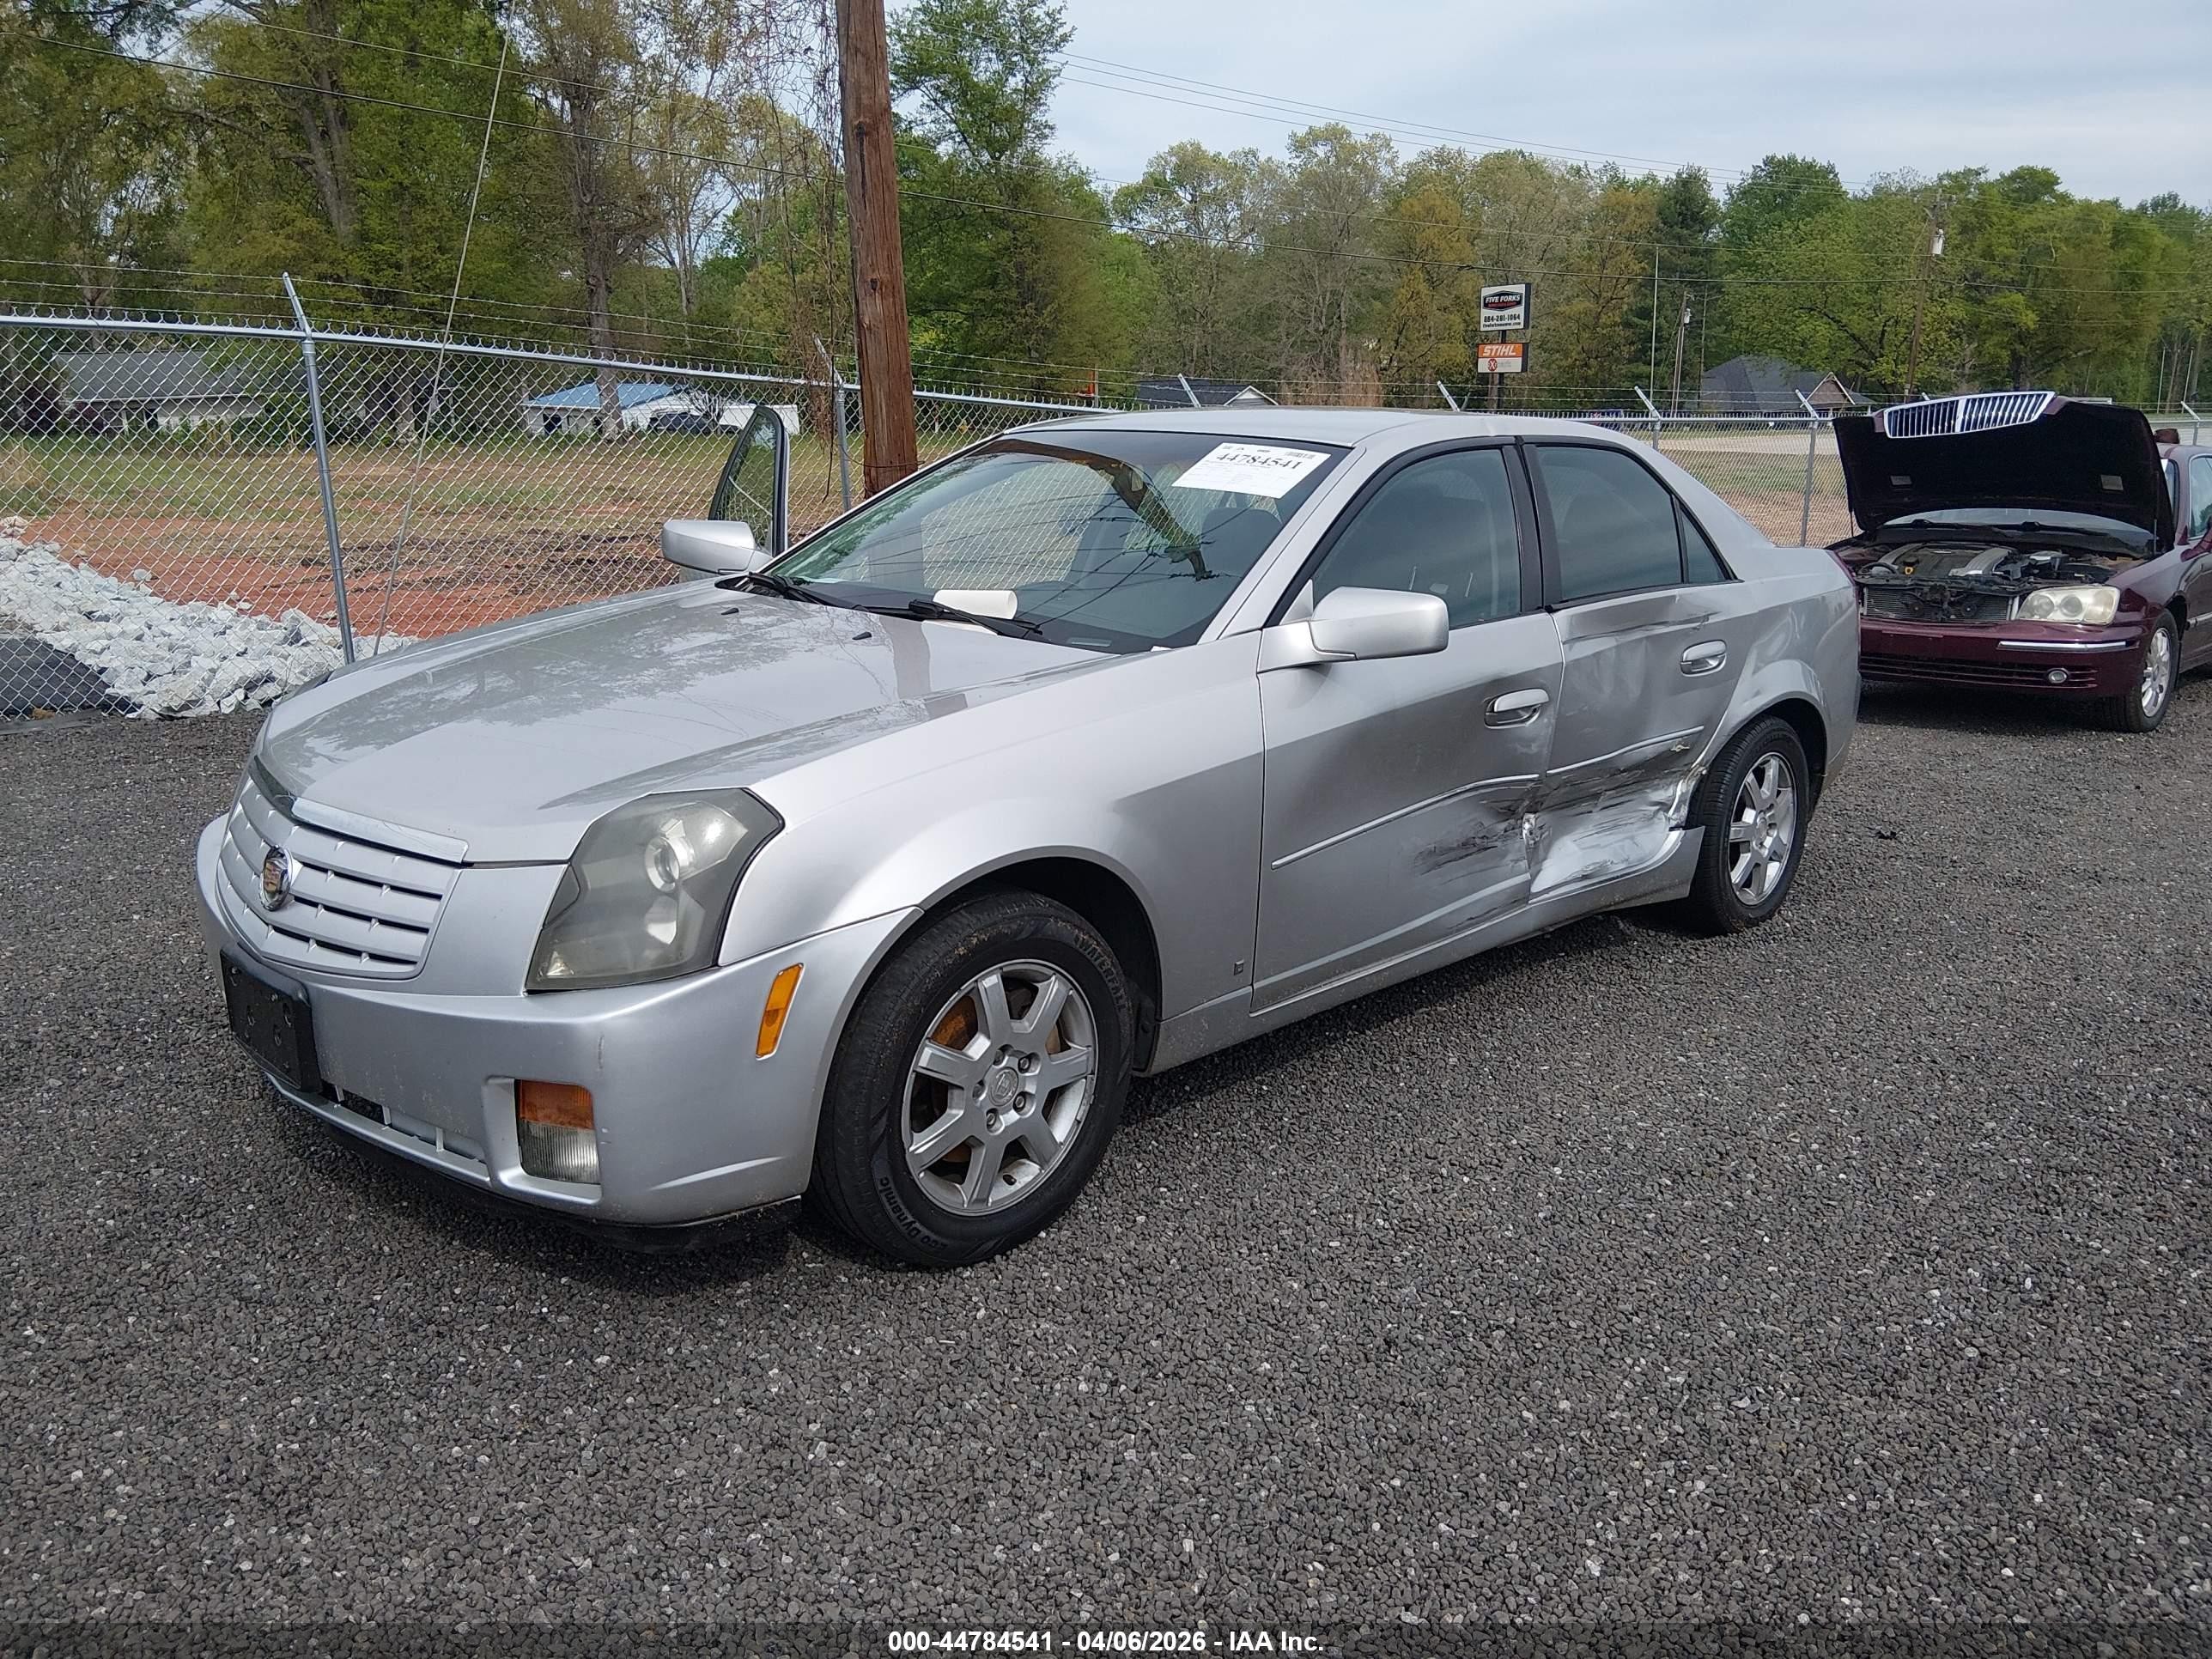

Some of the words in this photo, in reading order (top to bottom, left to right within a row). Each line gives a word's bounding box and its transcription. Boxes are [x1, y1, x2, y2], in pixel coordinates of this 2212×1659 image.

[1483, 344, 1516, 356] STIHL
[1216, 453, 1304, 470] 44784541
[878, 1176, 921, 1238] Dynamic
